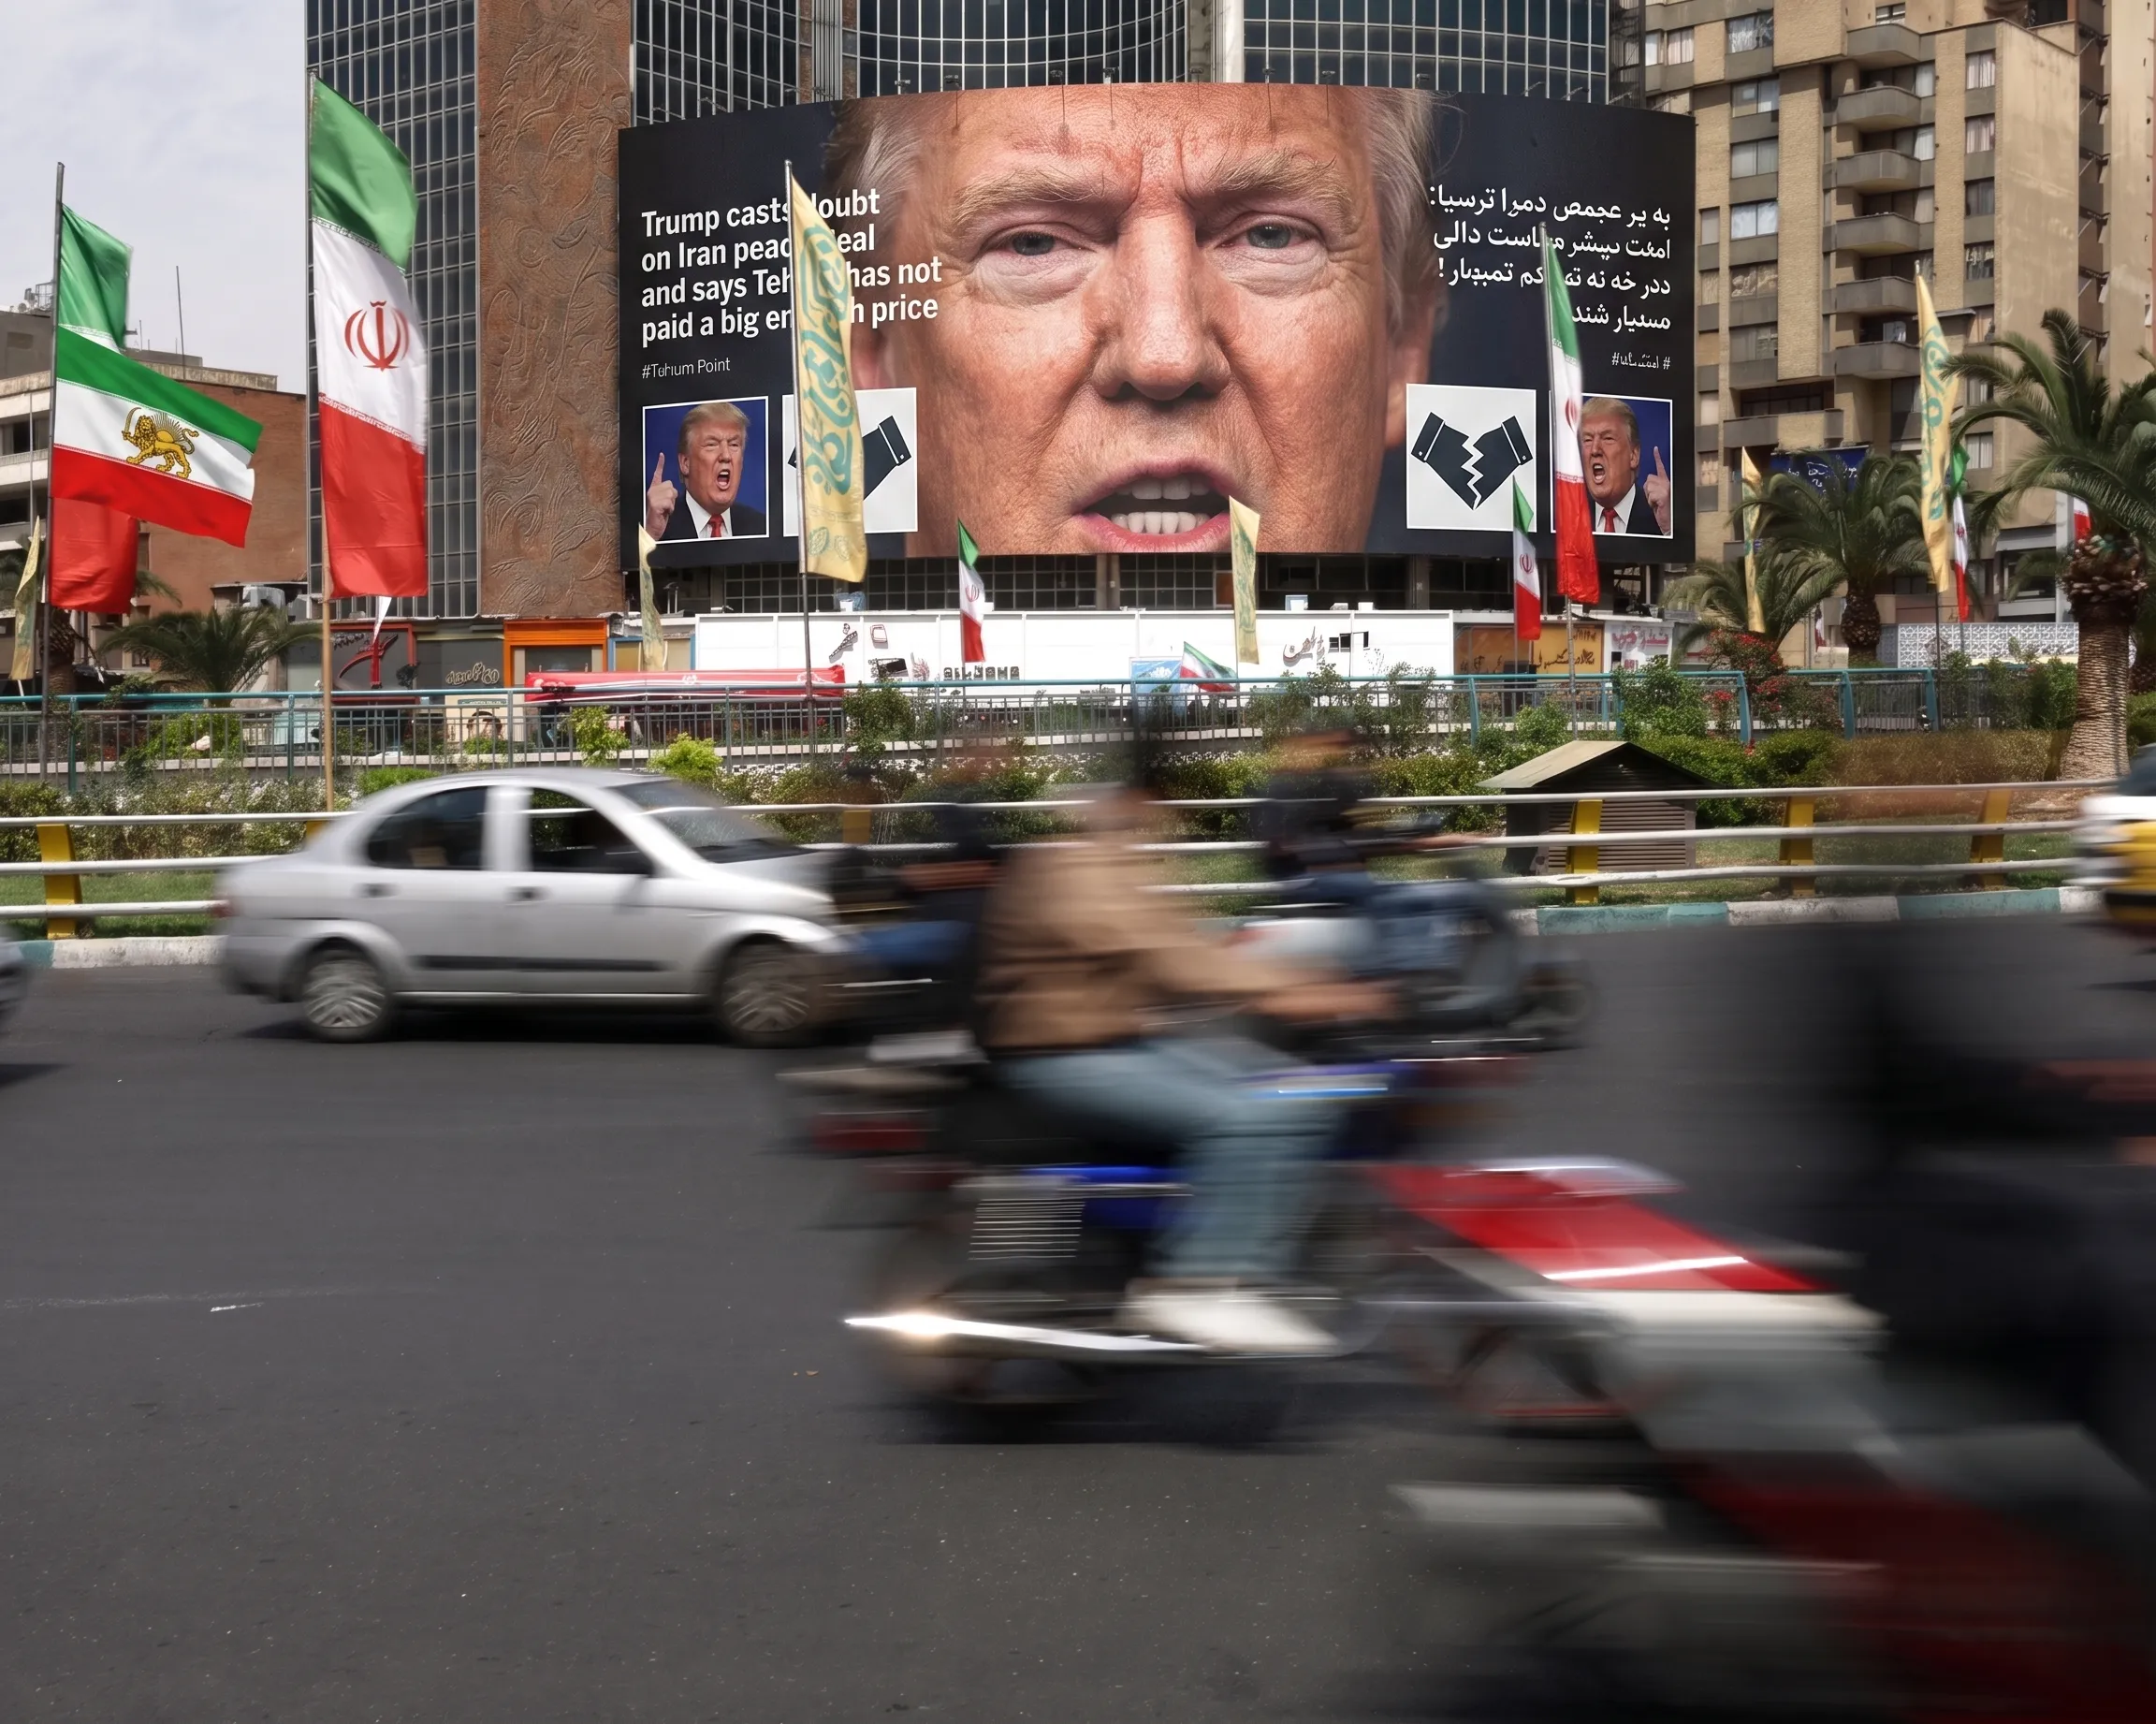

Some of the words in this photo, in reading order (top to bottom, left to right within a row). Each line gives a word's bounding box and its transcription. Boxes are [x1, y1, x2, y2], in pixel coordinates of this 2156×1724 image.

[641, 210, 720, 237] Trump
[641, 250, 671, 272] on
[678, 241, 726, 269] Iran
[734, 238, 791, 270] peac
[831, 223, 875, 253] eal
[641, 277, 686, 308] and
[692, 277, 748, 306] says
[752, 267, 792, 296] Teh
[846, 261, 891, 287] has
[898, 256, 943, 285] not
[642, 311, 693, 348] paid
[700, 315, 714, 336] a
[721, 306, 760, 339] big
[872, 293, 939, 329] price
[697, 357, 731, 373] Point
